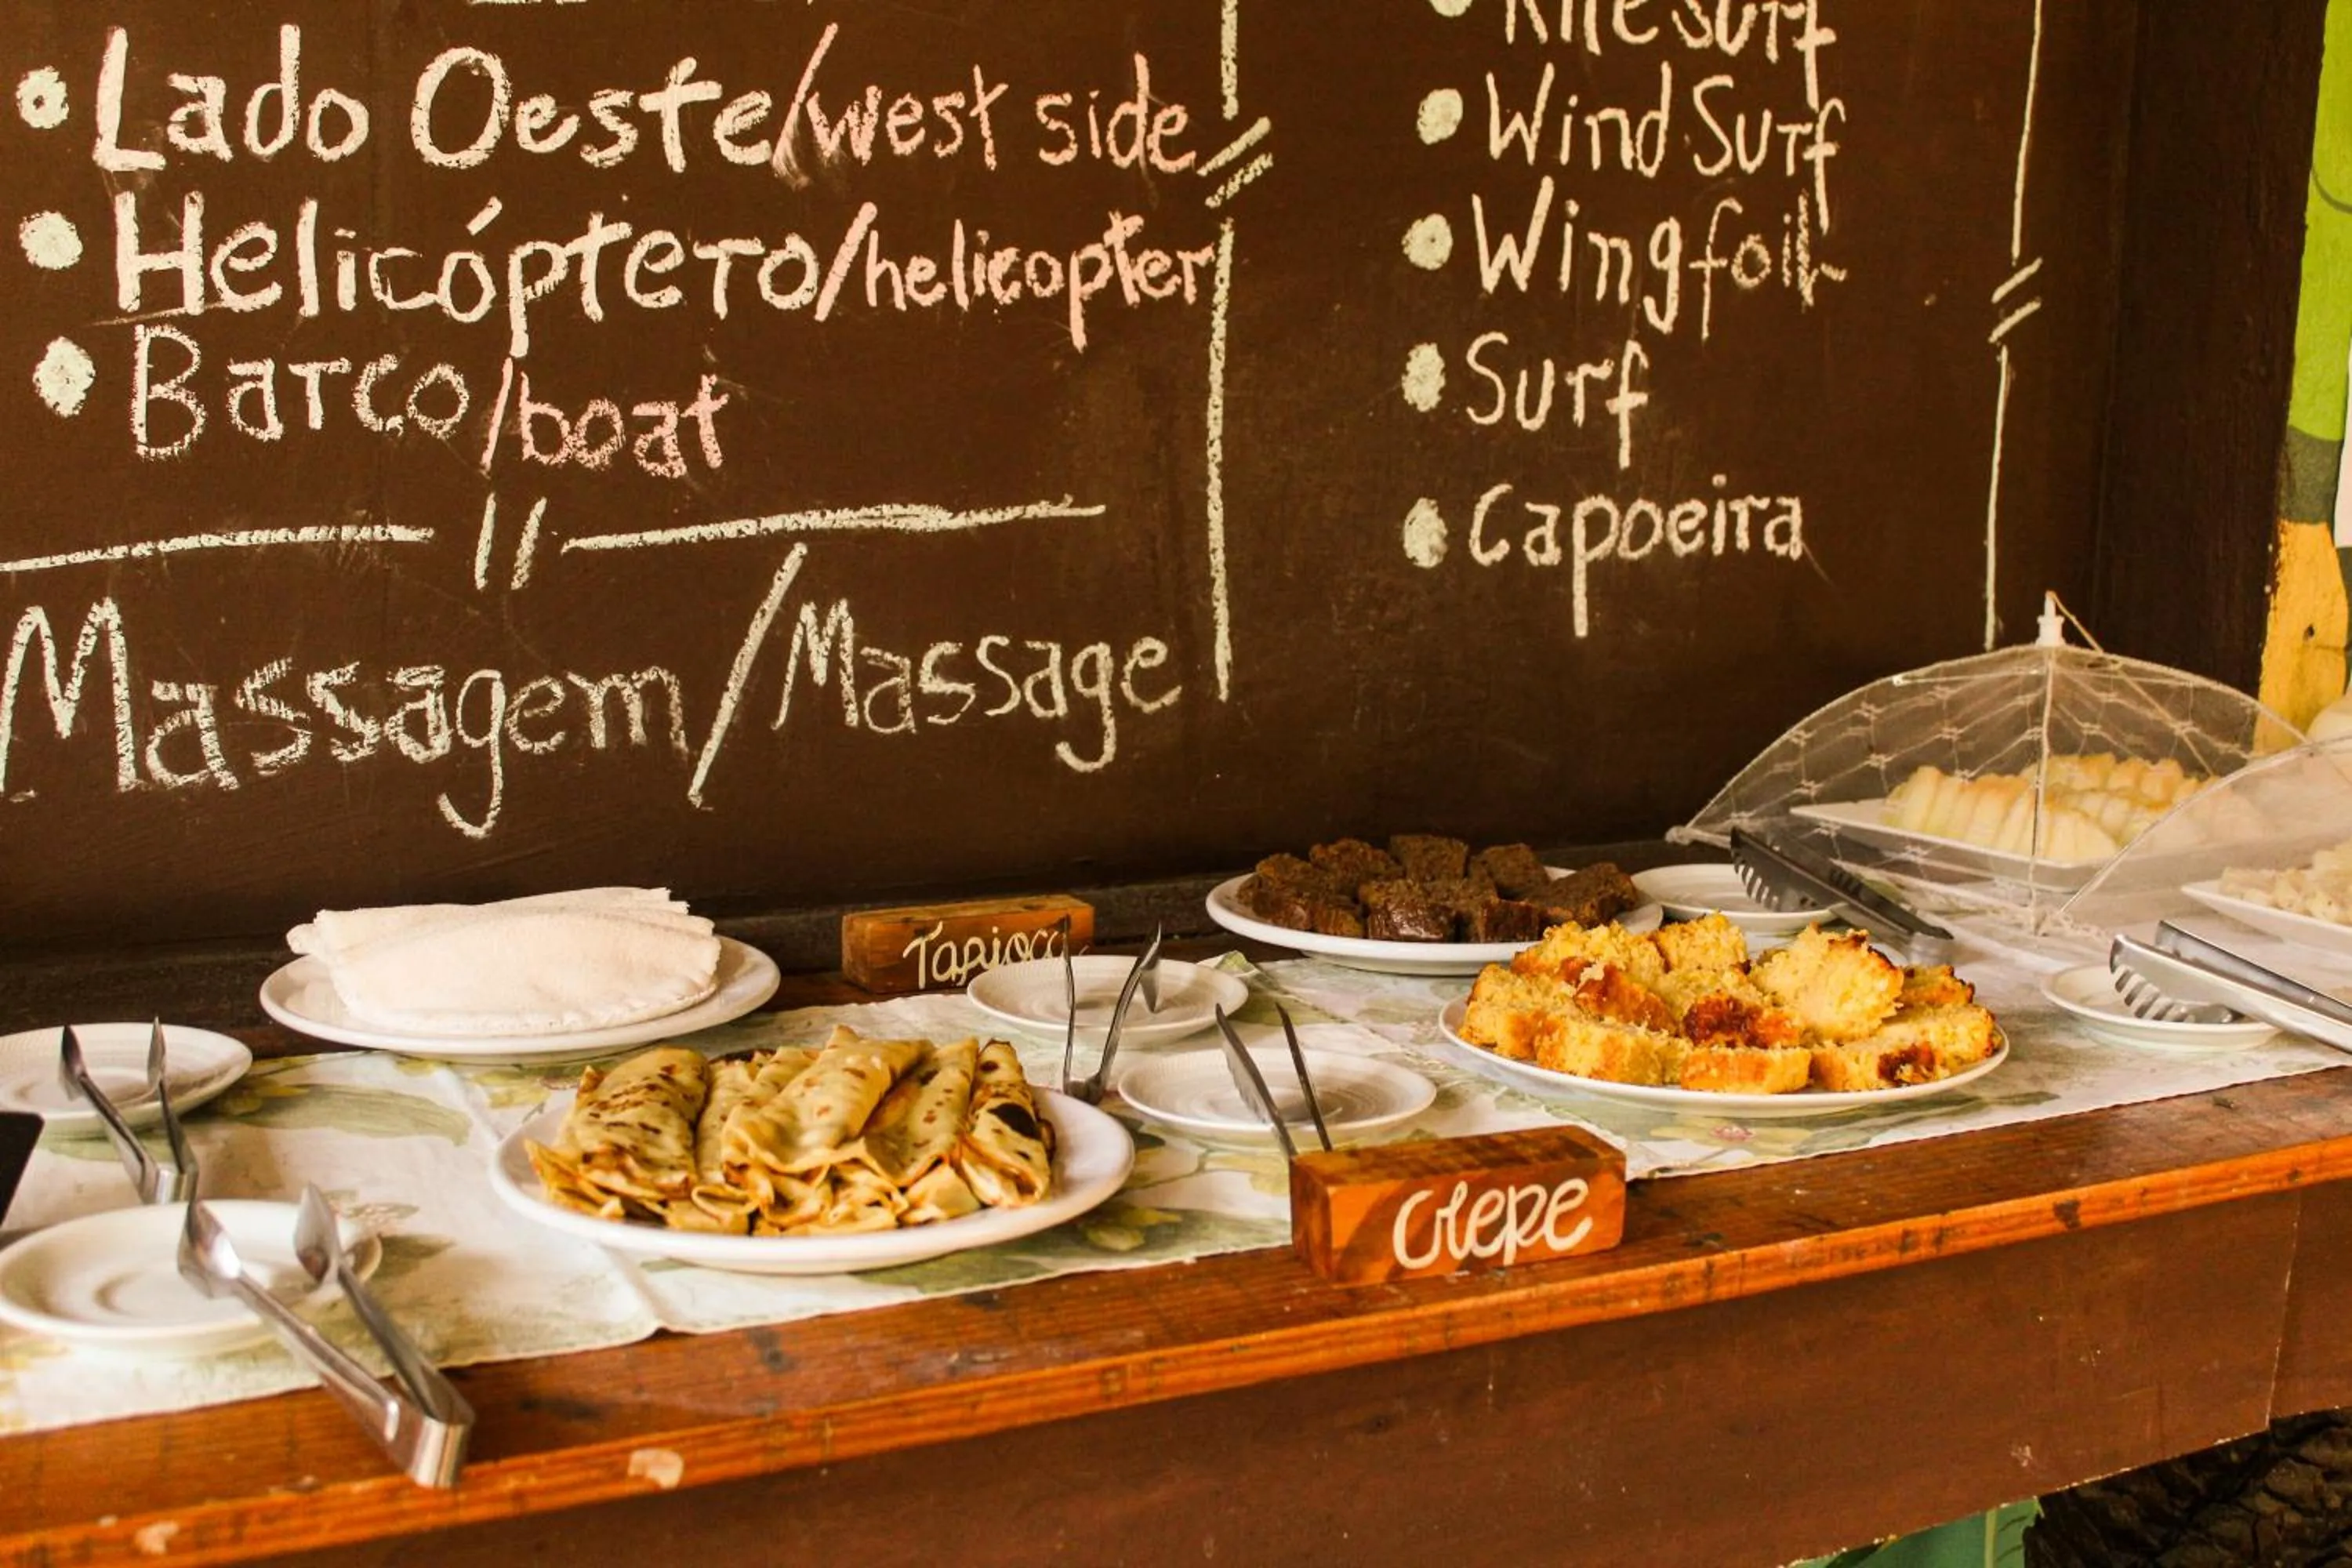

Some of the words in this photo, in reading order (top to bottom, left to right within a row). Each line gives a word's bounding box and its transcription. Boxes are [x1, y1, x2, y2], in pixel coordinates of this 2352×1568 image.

[93, 24, 369, 171] Lado
[1036, 52, 1196, 168] side
[1486, 61, 1671, 179] Wind
[1692, 75, 1846, 234] Surf
[1466, 332, 1649, 470] Surf
[1468, 474, 1803, 637] Capoeira
[1392, 1178, 1593, 1270] Crepe
